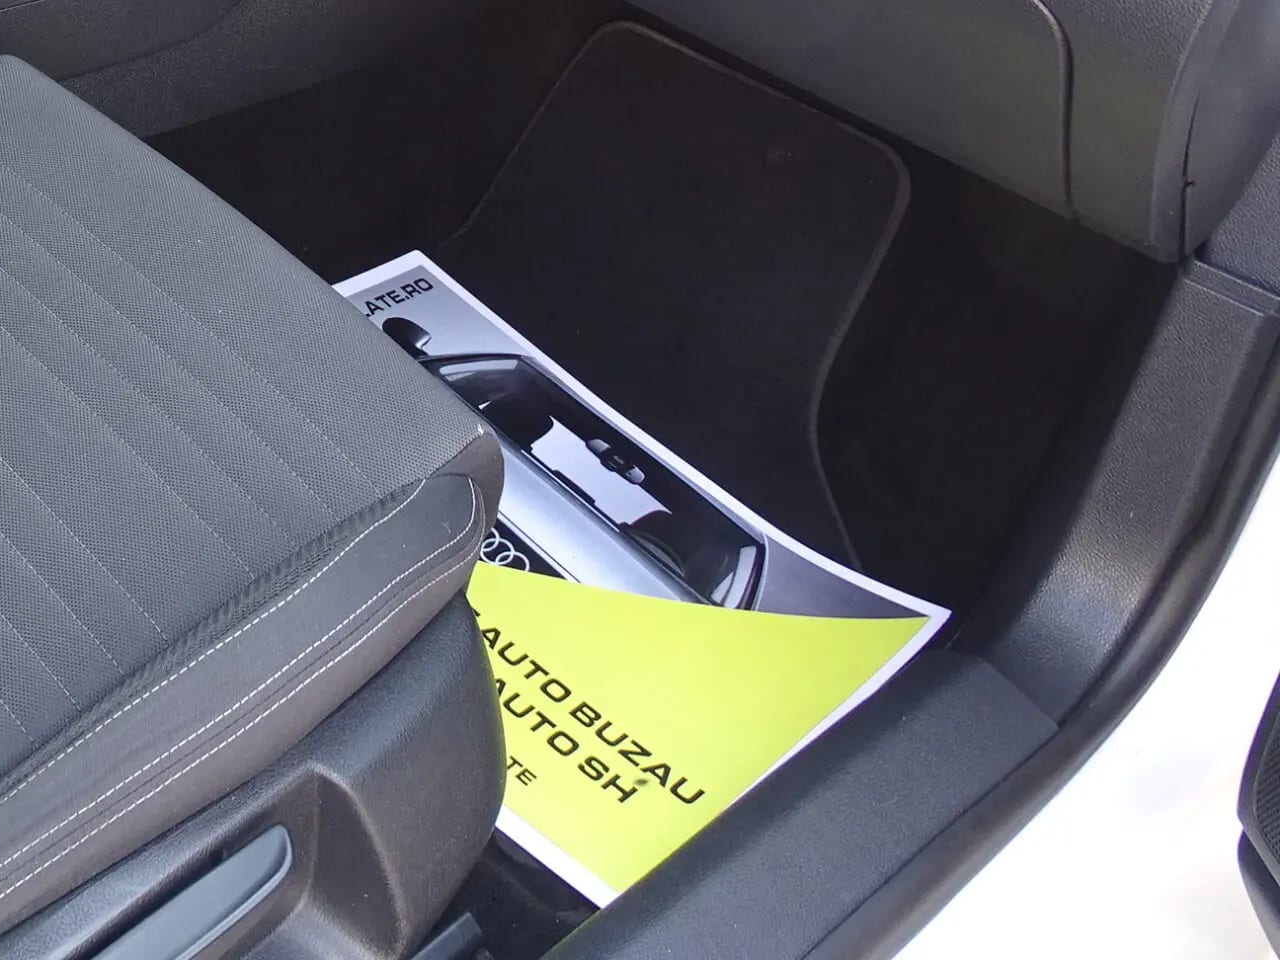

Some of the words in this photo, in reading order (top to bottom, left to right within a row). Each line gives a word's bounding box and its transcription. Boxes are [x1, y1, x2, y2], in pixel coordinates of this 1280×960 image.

[480, 626, 572, 703] AUTO
[568, 700, 706, 805] BUZAU
[578, 755, 639, 804] SH
